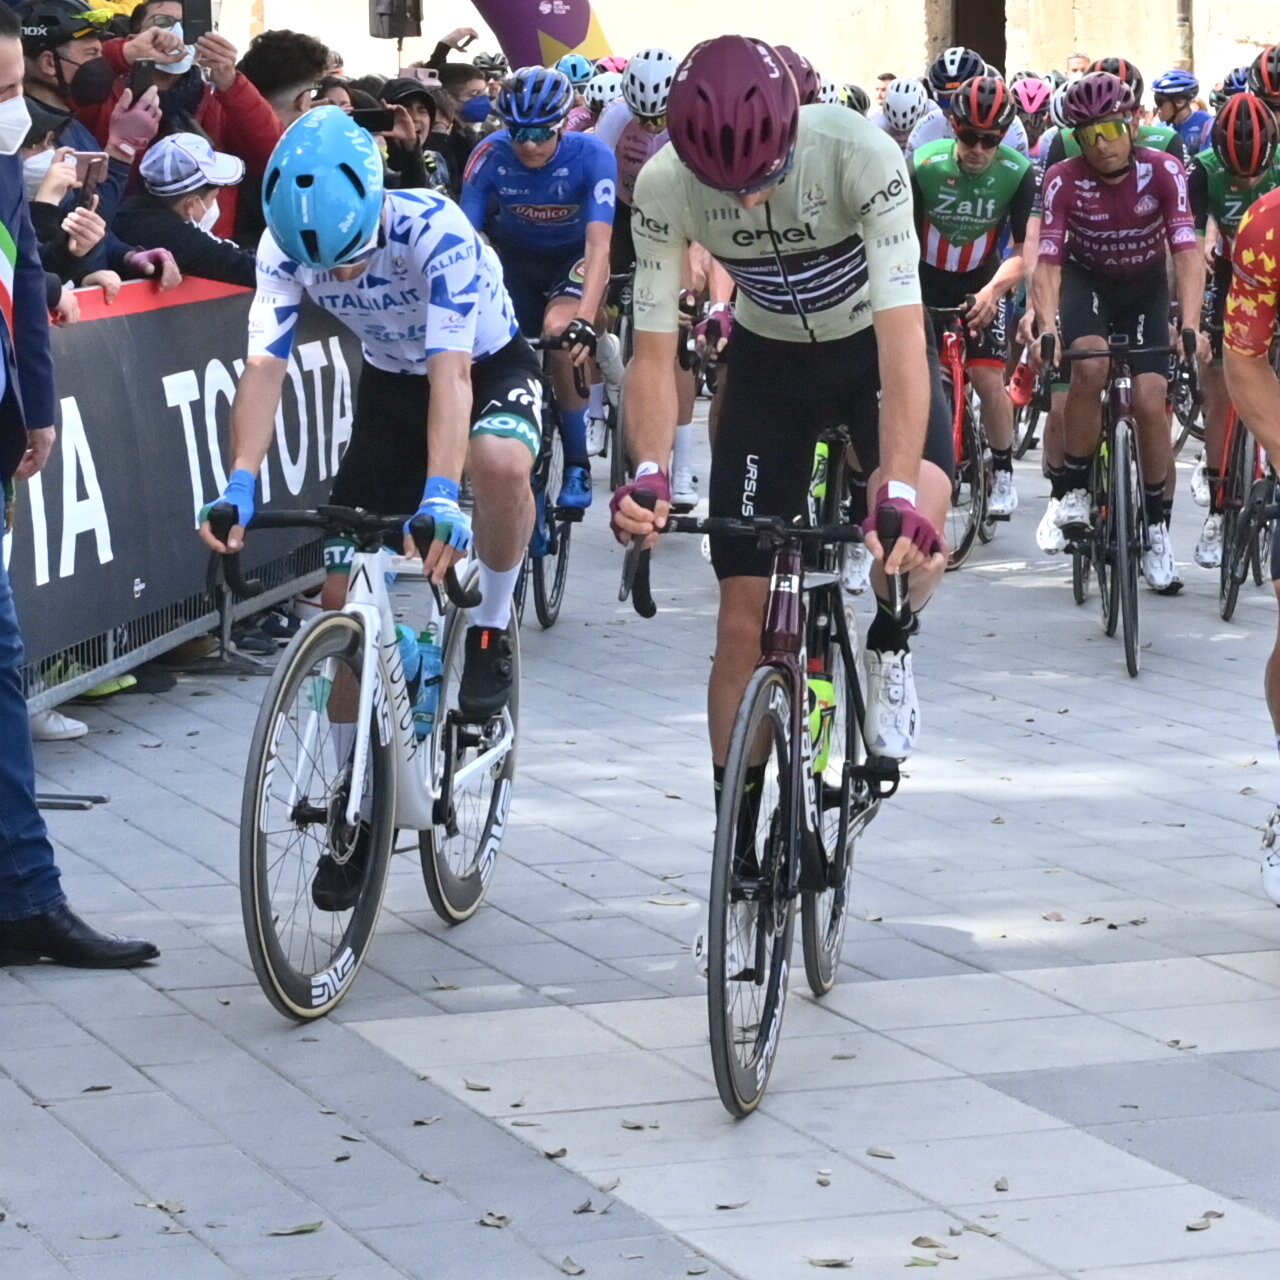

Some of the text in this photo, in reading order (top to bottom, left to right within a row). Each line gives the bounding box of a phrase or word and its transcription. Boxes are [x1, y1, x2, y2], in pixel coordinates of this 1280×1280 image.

[859, 169, 908, 216] enel
[934, 193, 996, 218] Zalf
[732, 222, 817, 247] enel
[741, 453, 760, 517] URSUS
